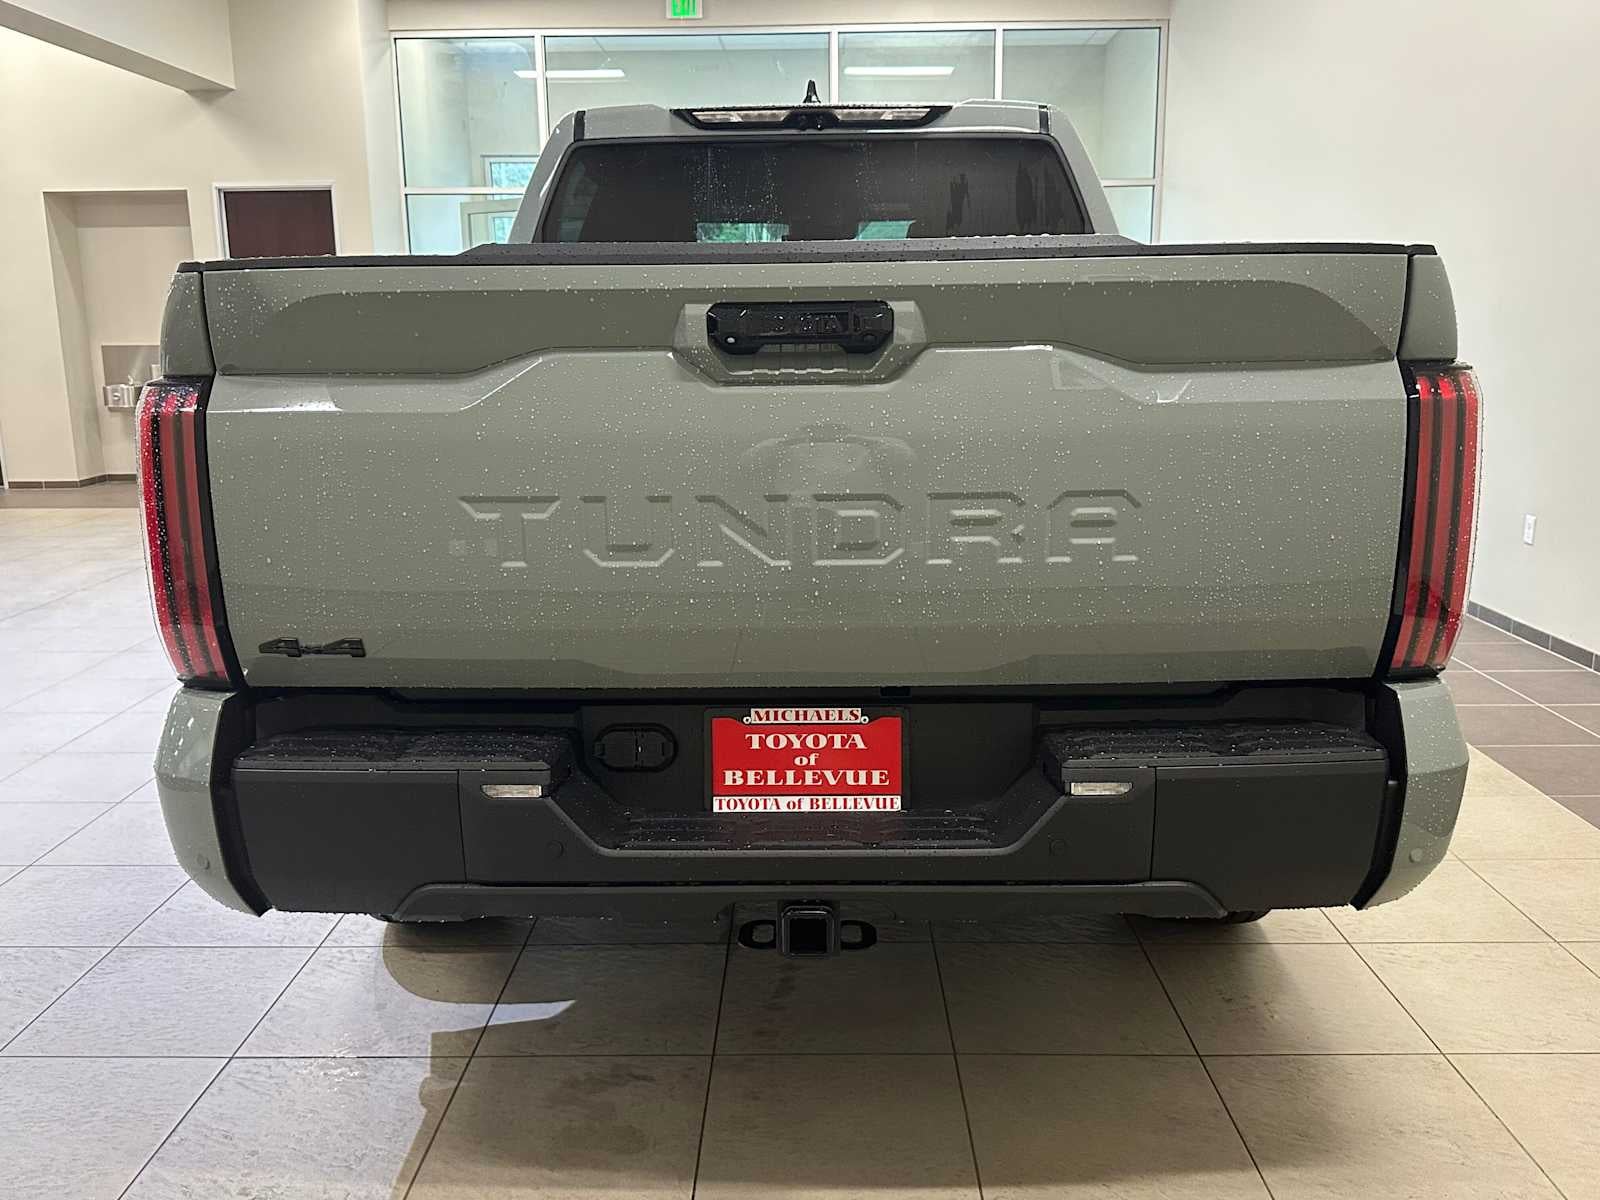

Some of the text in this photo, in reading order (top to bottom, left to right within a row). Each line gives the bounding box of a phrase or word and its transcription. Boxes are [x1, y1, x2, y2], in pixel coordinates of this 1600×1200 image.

[458, 489, 1142, 568] TUNDRA
[753, 709, 860, 722] MICHAELS
[745, 733, 867, 750] TOYOTA
[794, 753, 819, 766] of
[723, 769, 889, 786] BELLEVUE
[715, 797, 900, 811] TOYOTA of BELLEVUE
